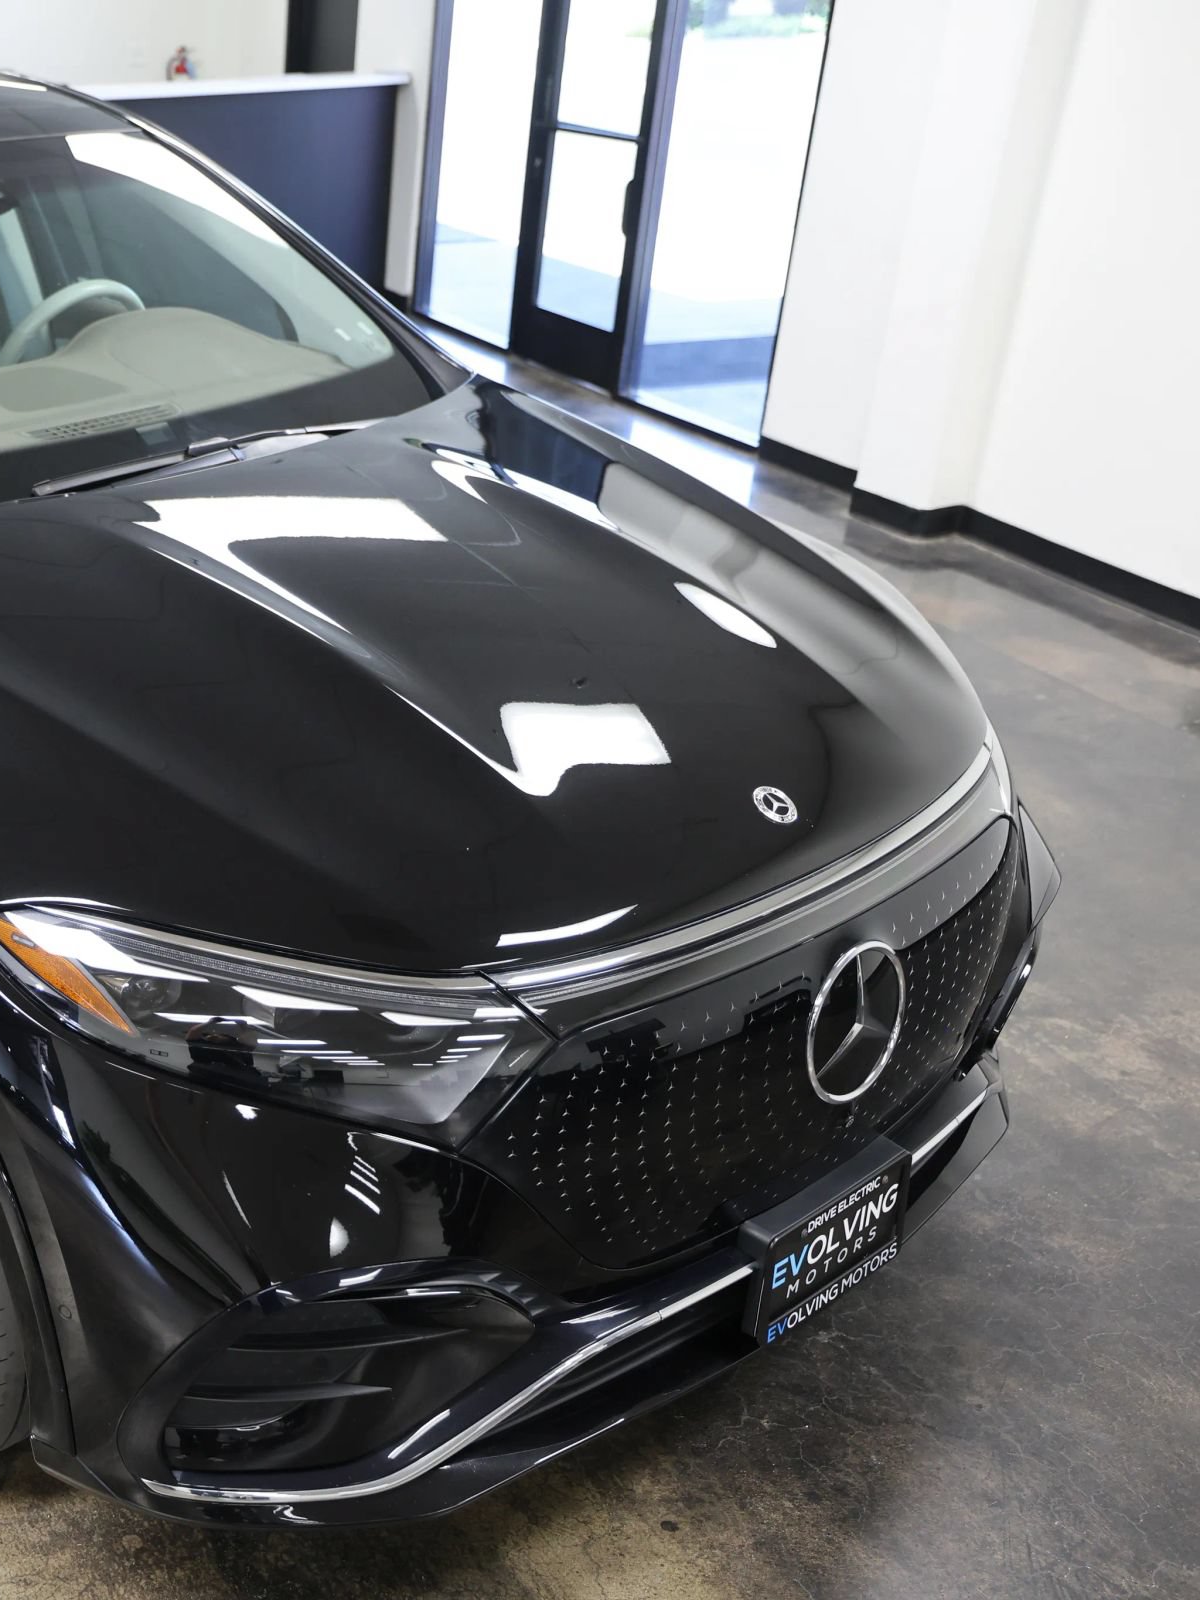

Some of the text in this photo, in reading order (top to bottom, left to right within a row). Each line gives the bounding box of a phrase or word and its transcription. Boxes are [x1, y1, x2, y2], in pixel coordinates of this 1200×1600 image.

[772, 1183, 899, 1289] EVOLVING
[807, 1176, 881, 1233] DRIVE ELECTRIC
[767, 1242, 898, 1343] EVOLVING MOTORS
[786, 1226, 877, 1299] MOTORS
